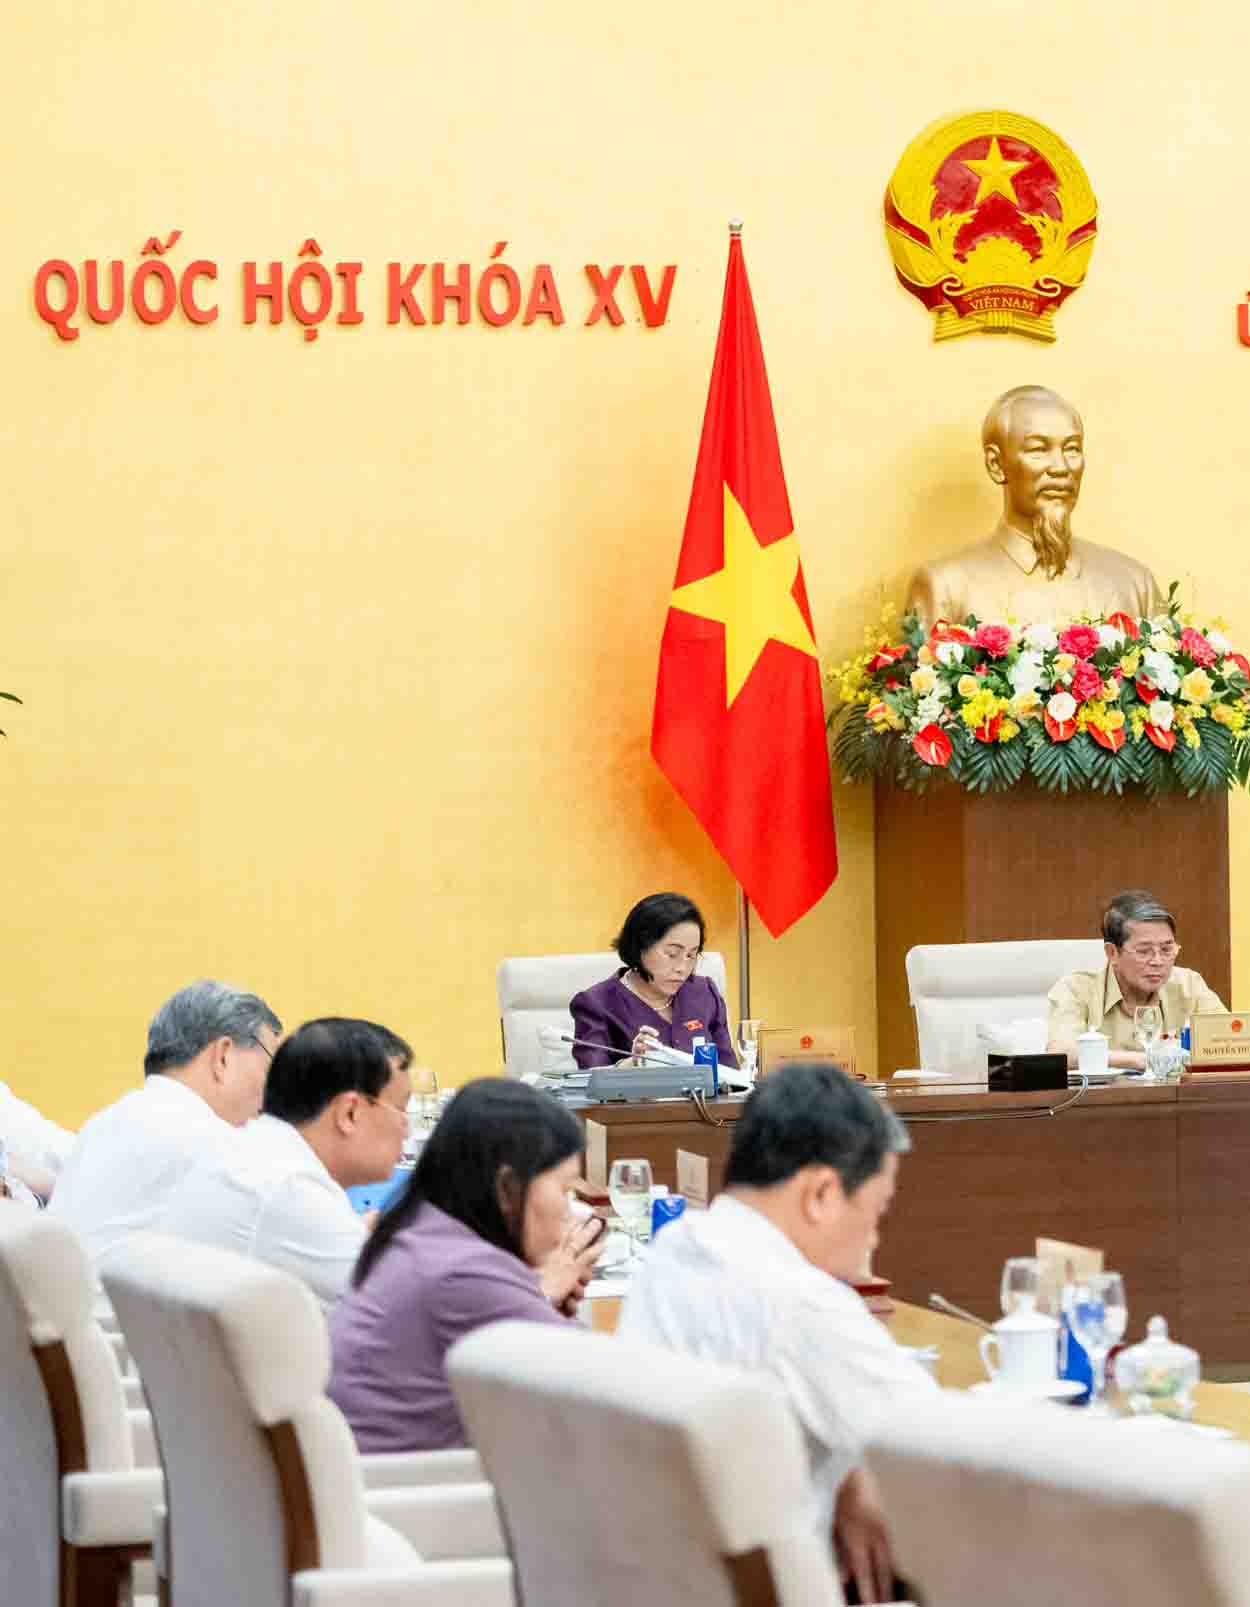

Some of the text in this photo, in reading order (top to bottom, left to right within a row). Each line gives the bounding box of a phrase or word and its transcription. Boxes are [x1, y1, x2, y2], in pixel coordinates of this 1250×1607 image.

[33, 231, 678, 343] QUỐC HỘI KHÓA XV
[1002, 297, 1035, 312] NAM
